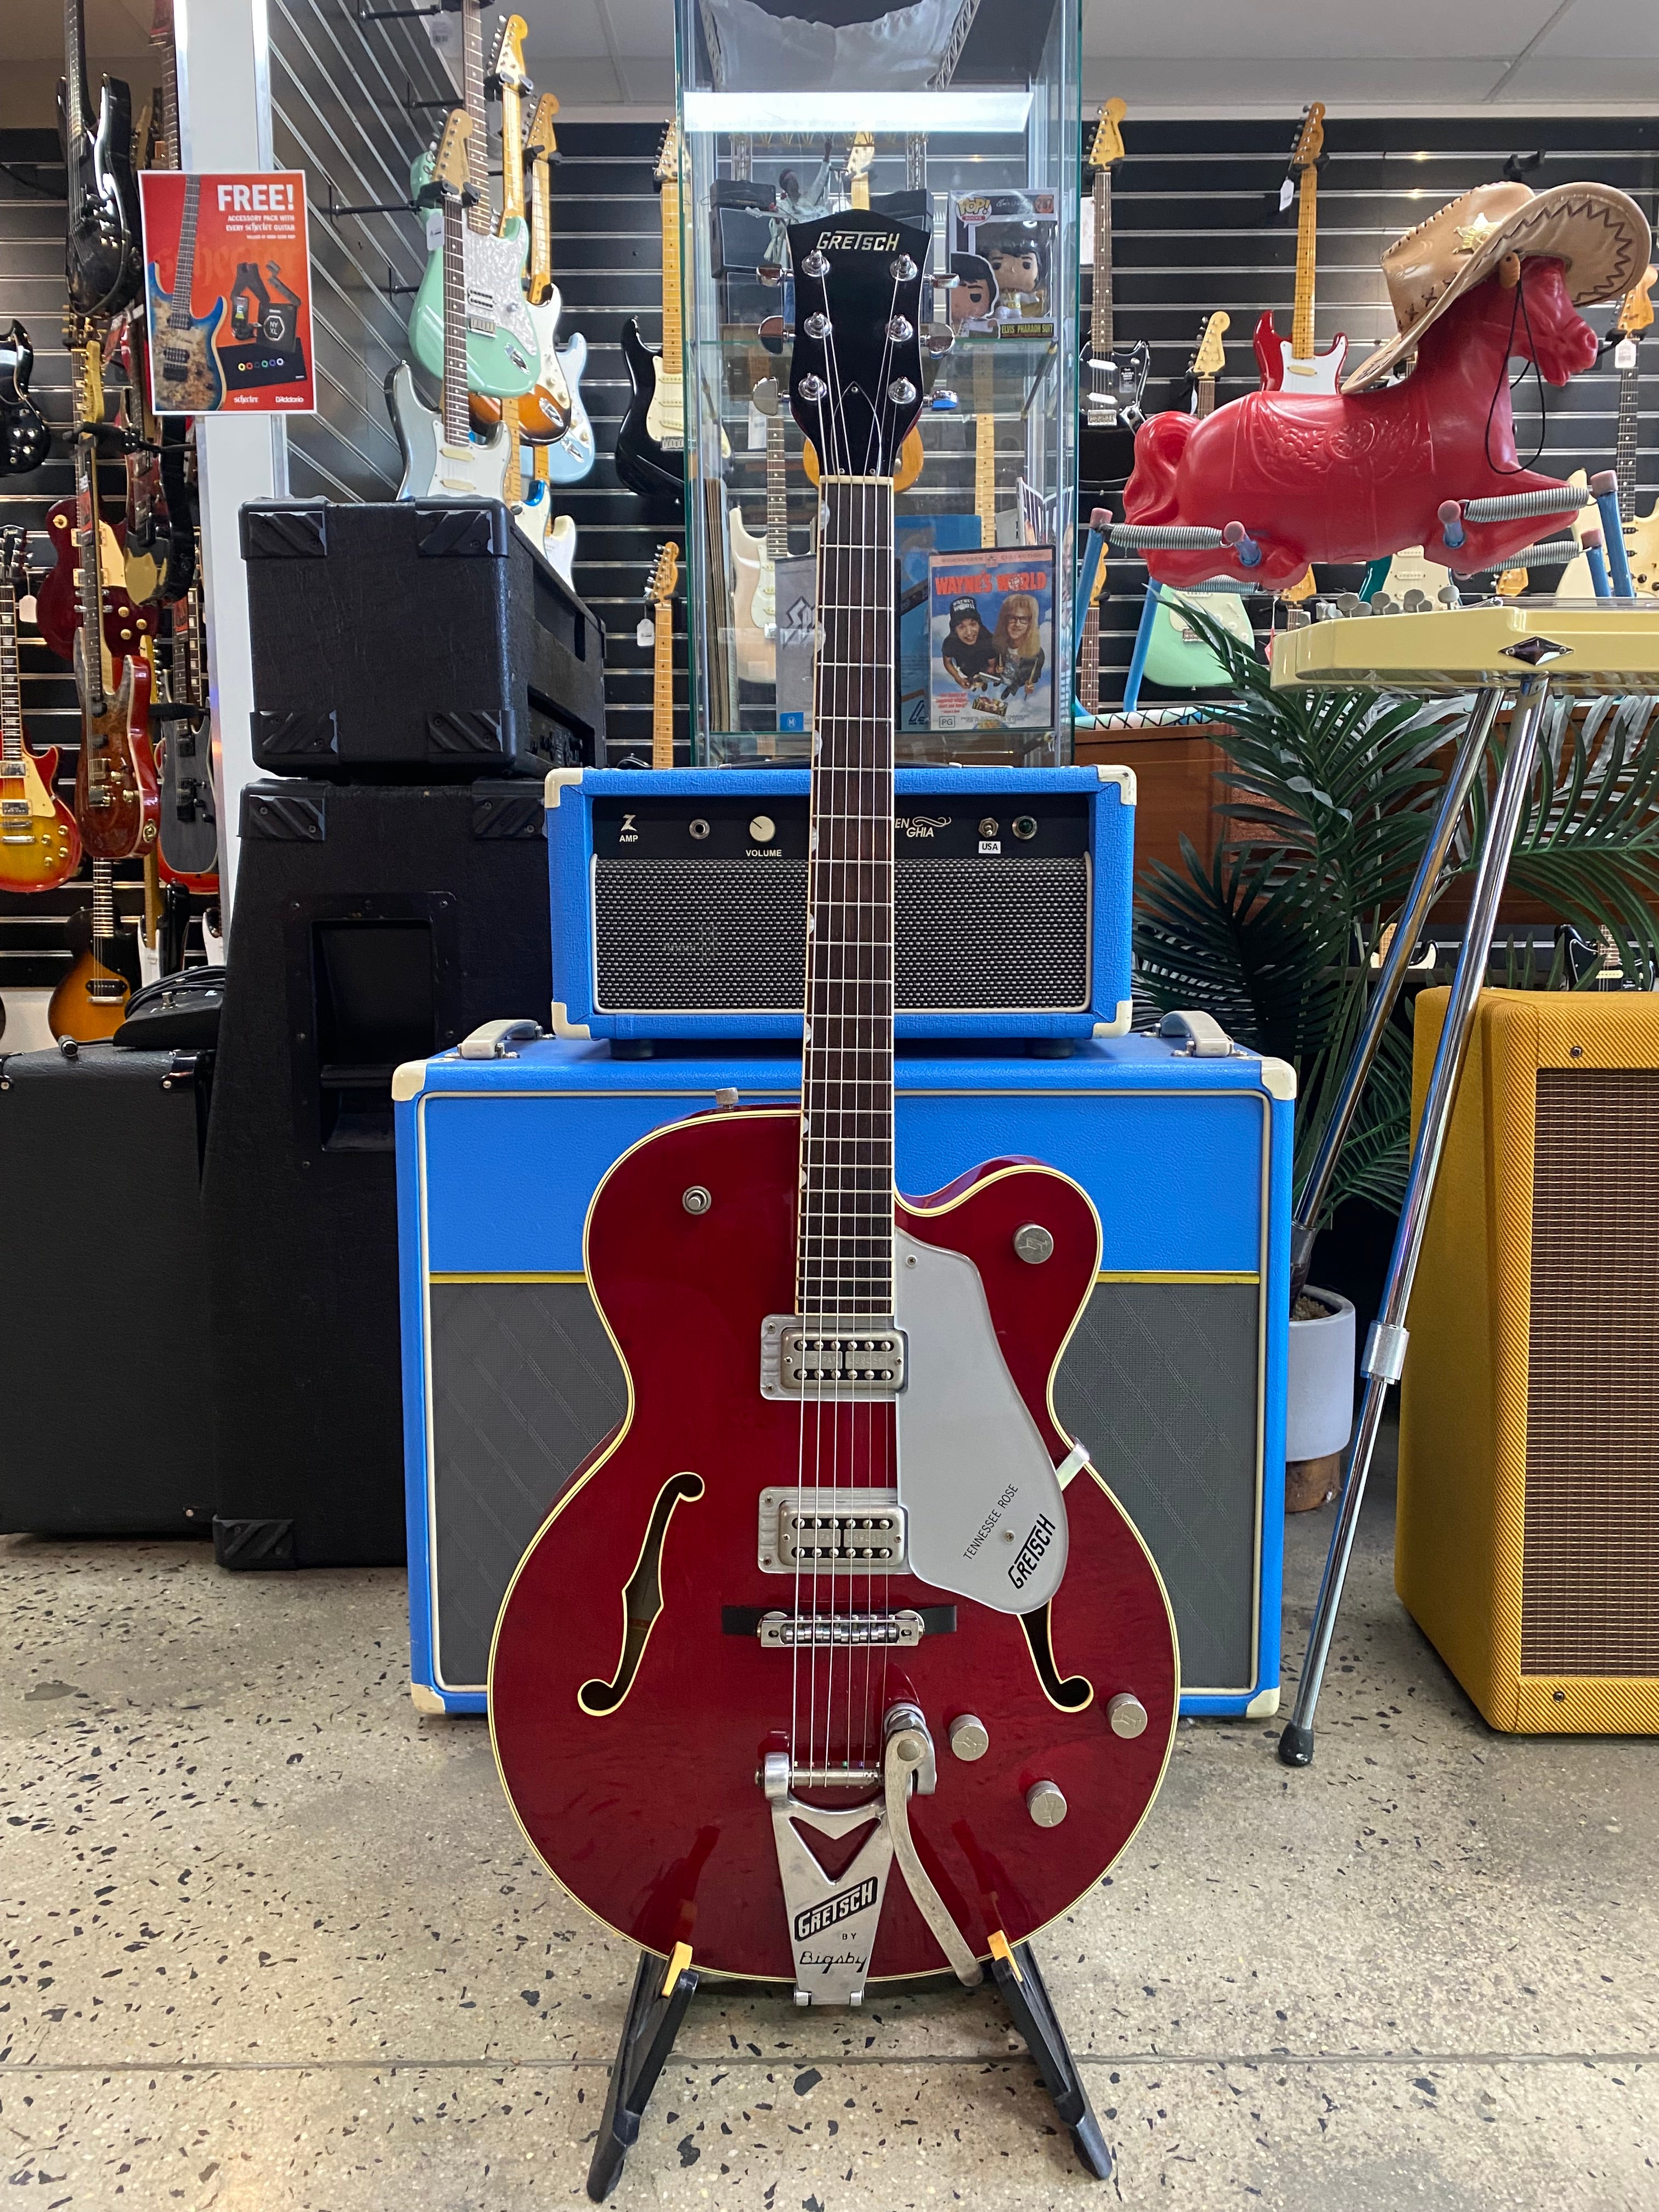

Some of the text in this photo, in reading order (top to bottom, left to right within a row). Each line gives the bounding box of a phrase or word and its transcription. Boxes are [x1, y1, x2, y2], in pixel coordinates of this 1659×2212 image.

[217, 184, 294, 211] FREE!
[958, 198, 991, 216] POP!
[245, 222, 272, 233] schecter
[816, 230, 900, 251] GRETSCH
[1001, 325, 1015, 334] ELVIS
[1042, 324, 1053, 333] SUIT
[934, 570, 1047, 596] WAYNE'S WORLD
[895, 818, 910, 828] EN
[906, 827, 934, 838] GHIA
[619, 834, 639, 843] AMP
[963, 1483, 1019, 1560] TENNESSEE ROSE
[1007, 1513, 1056, 1589] GRETSCH
[798, 1880, 873, 1938] GRETSCH
[799, 1951, 867, 1974] Bigsby
